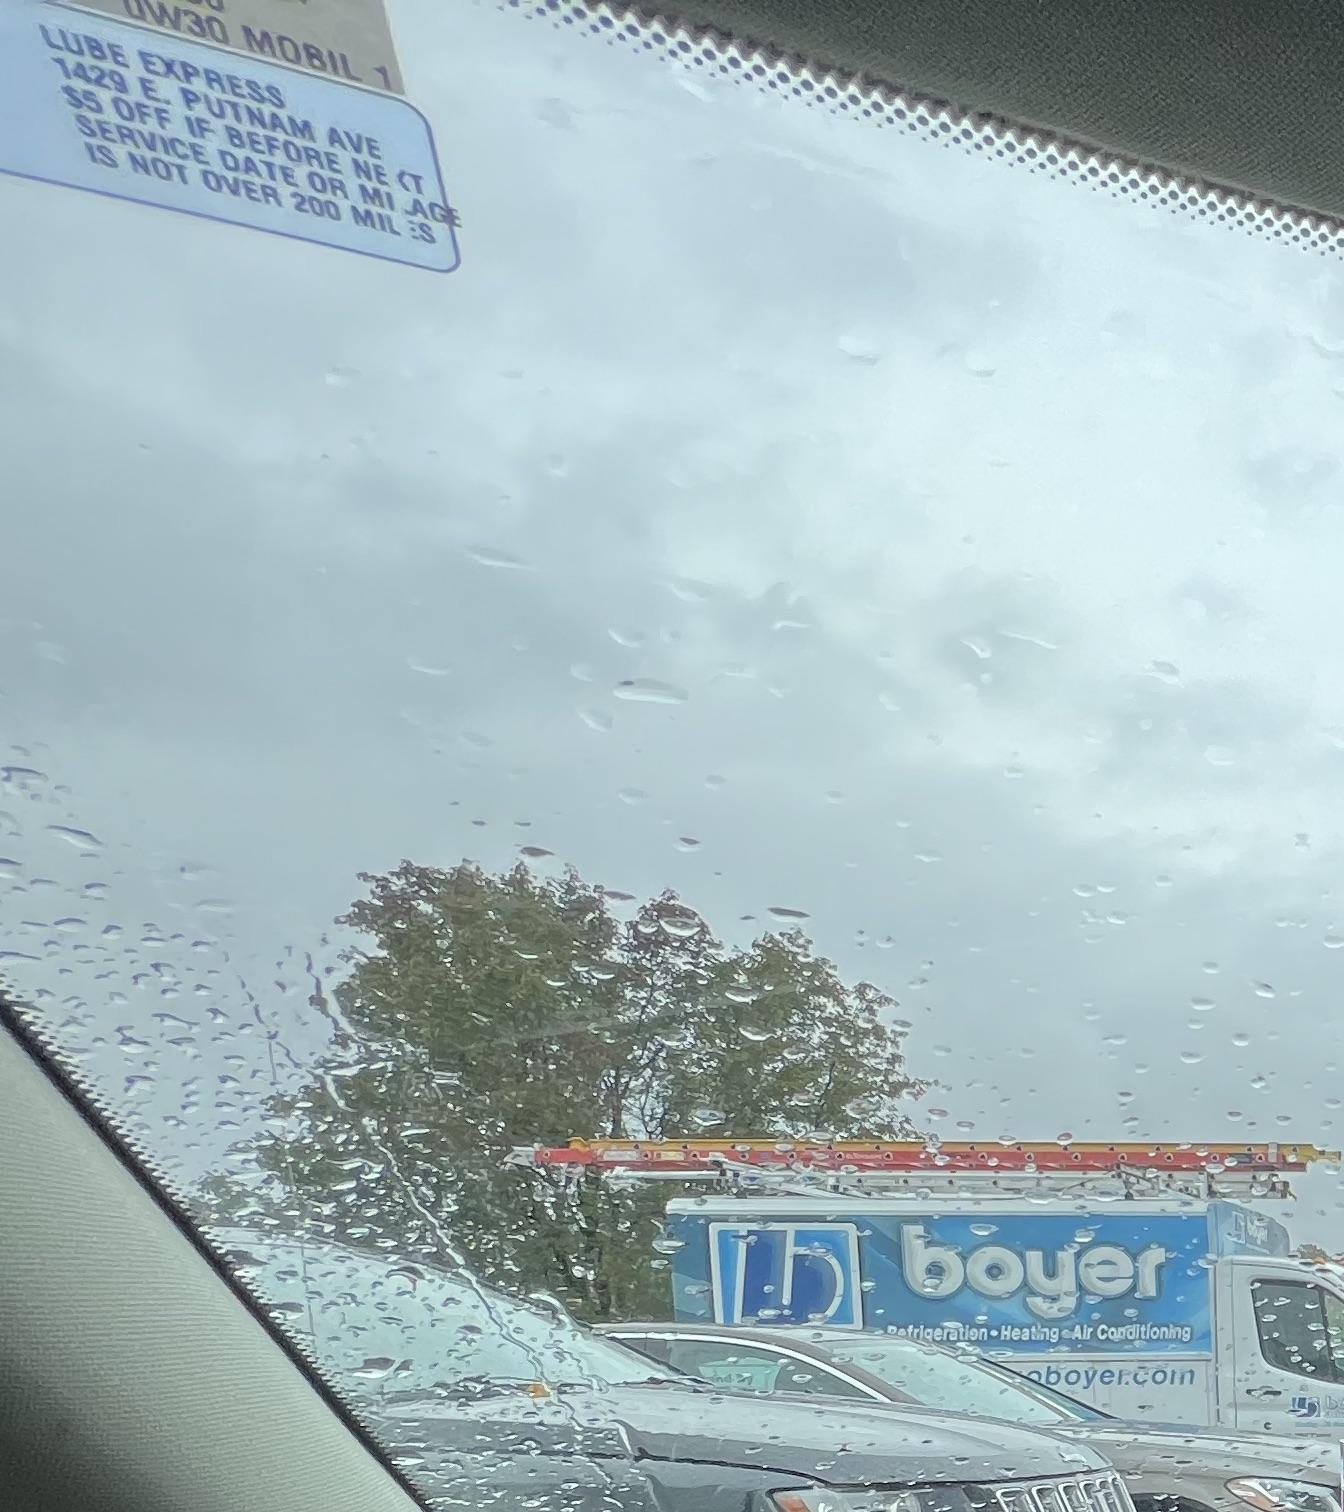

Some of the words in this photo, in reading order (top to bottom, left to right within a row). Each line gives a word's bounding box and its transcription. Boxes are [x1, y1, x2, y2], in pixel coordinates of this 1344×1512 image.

[39, 24, 129, 68] LUBE
[138, 50, 286, 109] EXPRESS
[241, 25, 362, 82] MOBIL
[374, 65, 391, 90] 1
[52, 57, 128, 95] 1429
[179, 87, 316, 143] PUTNAM
[328, 127, 382, 160] AVE
[112, 96, 171, 130] OFF
[185, 116, 215, 139] IF
[224, 125, 343, 175] BEFORE
[75, 114, 210, 166] SERVICE
[218, 150, 299, 187] DATE
[308, 172, 349, 200] OR
[358, 183, 462, 228] MIAGE
[84, 142, 119, 168] IS
[128, 151, 188, 185] NOT
[201, 169, 282, 208] OVER
[290, 192, 342, 221] 200
[901, 1224, 1166, 1319] boyer
[1000, 1323, 1060, 1344] Heating
[1072, 1324, 1093, 1340] Air
[1097, 1323, 1191, 1343] Conditioning
